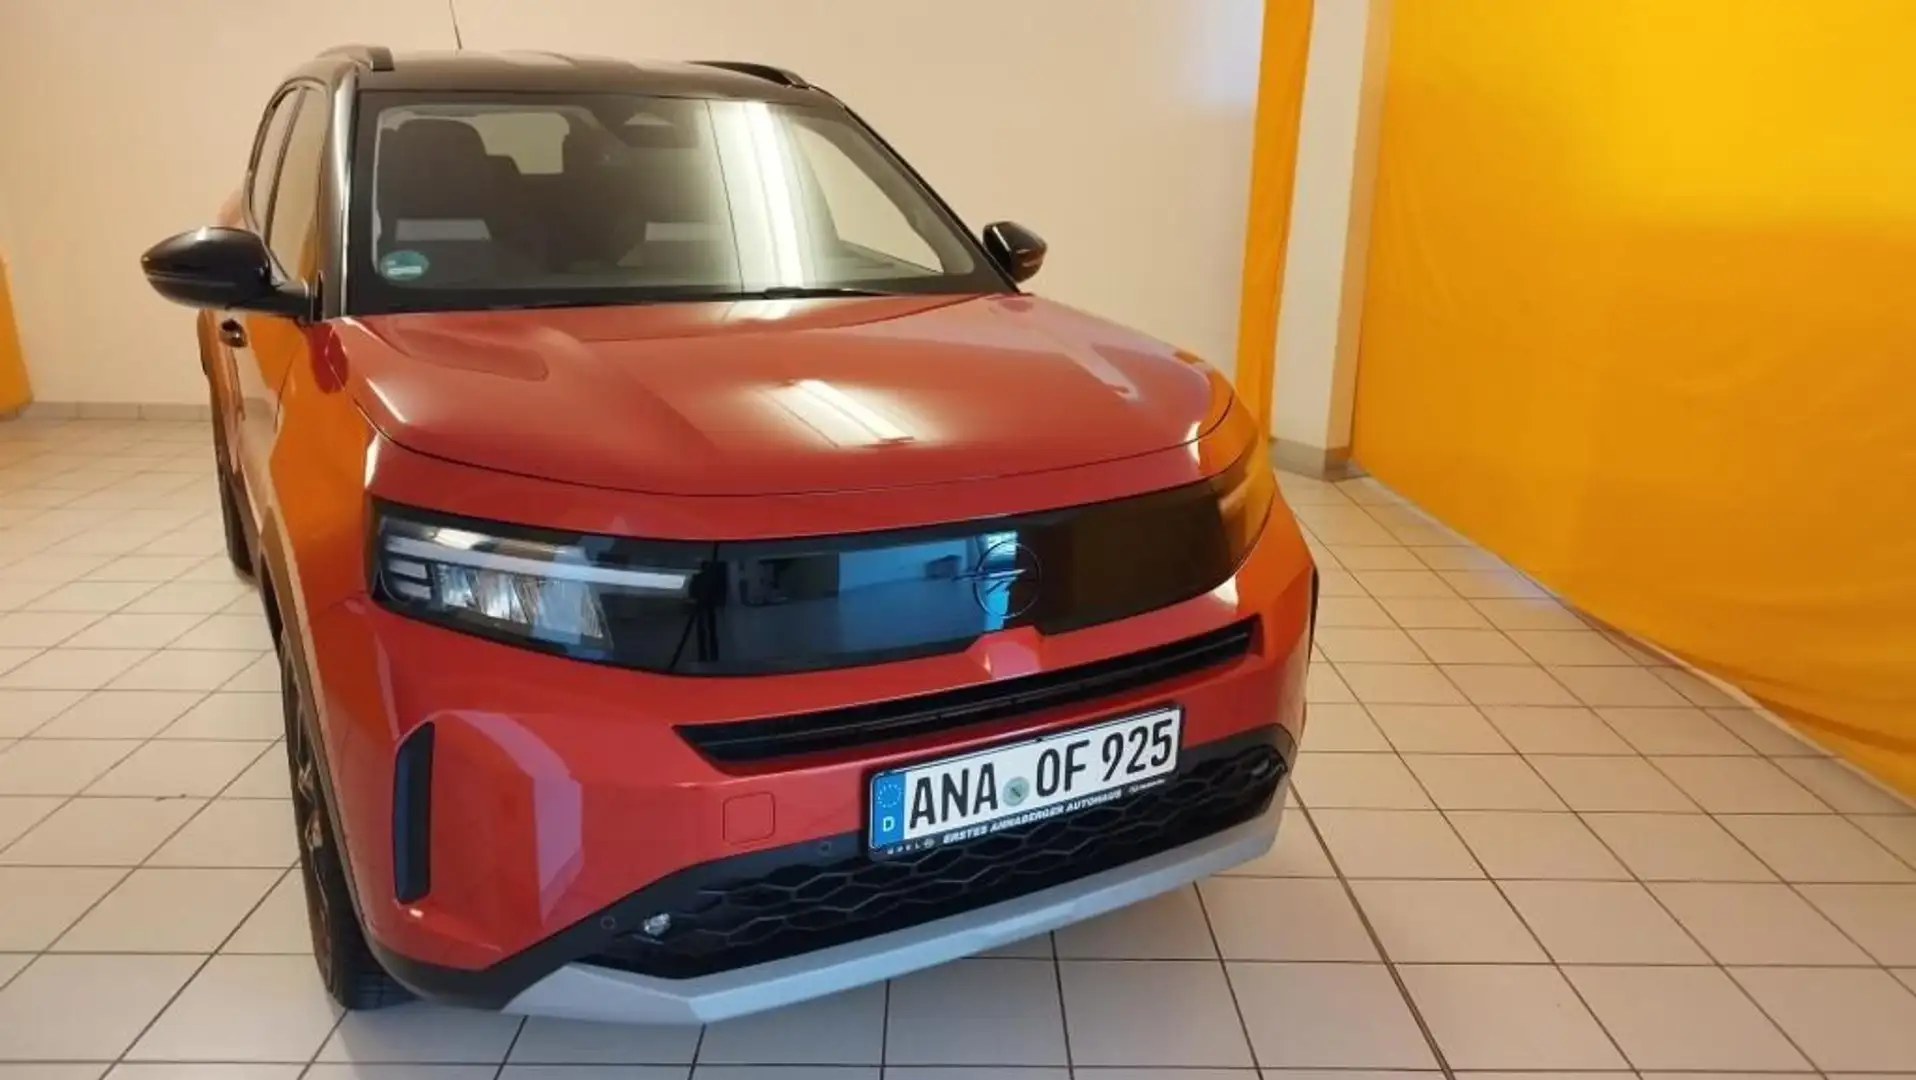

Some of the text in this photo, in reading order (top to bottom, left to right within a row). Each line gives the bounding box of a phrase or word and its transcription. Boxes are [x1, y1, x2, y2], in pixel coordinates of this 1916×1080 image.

[882, 719, 1173, 832] D ANA OF 925
[943, 788, 1122, 844] ERSTES ANNABERGER AUTOHAUS
